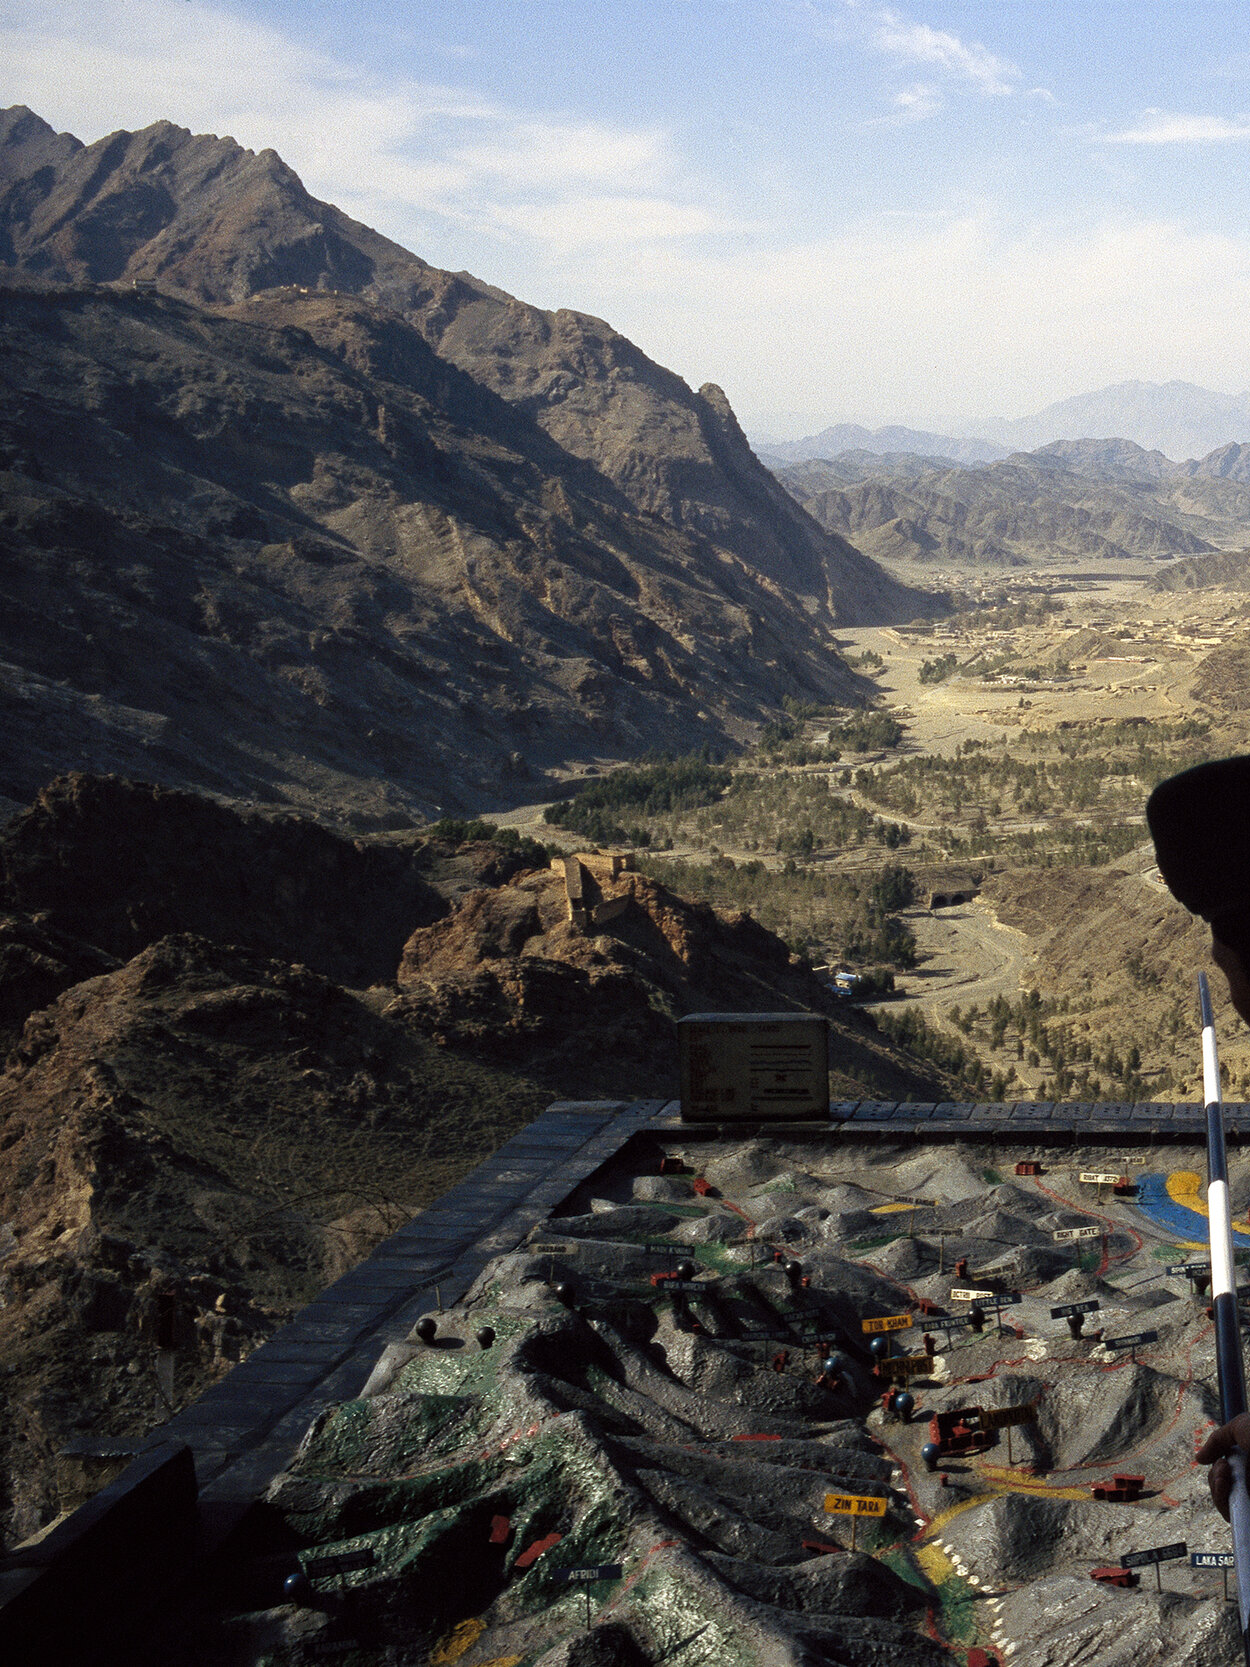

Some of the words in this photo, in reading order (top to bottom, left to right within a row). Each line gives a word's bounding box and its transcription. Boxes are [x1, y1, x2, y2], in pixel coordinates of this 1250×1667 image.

[1079, 1227, 1097, 1237] GATE
[887, 1316, 909, 1328] KHAM
[833, 1498, 852, 1511] ZIN
[856, 1499, 880, 1513] TARA
[1195, 1555, 1217, 1566] LAKA
[567, 1569, 600, 1581] AFRIDI
